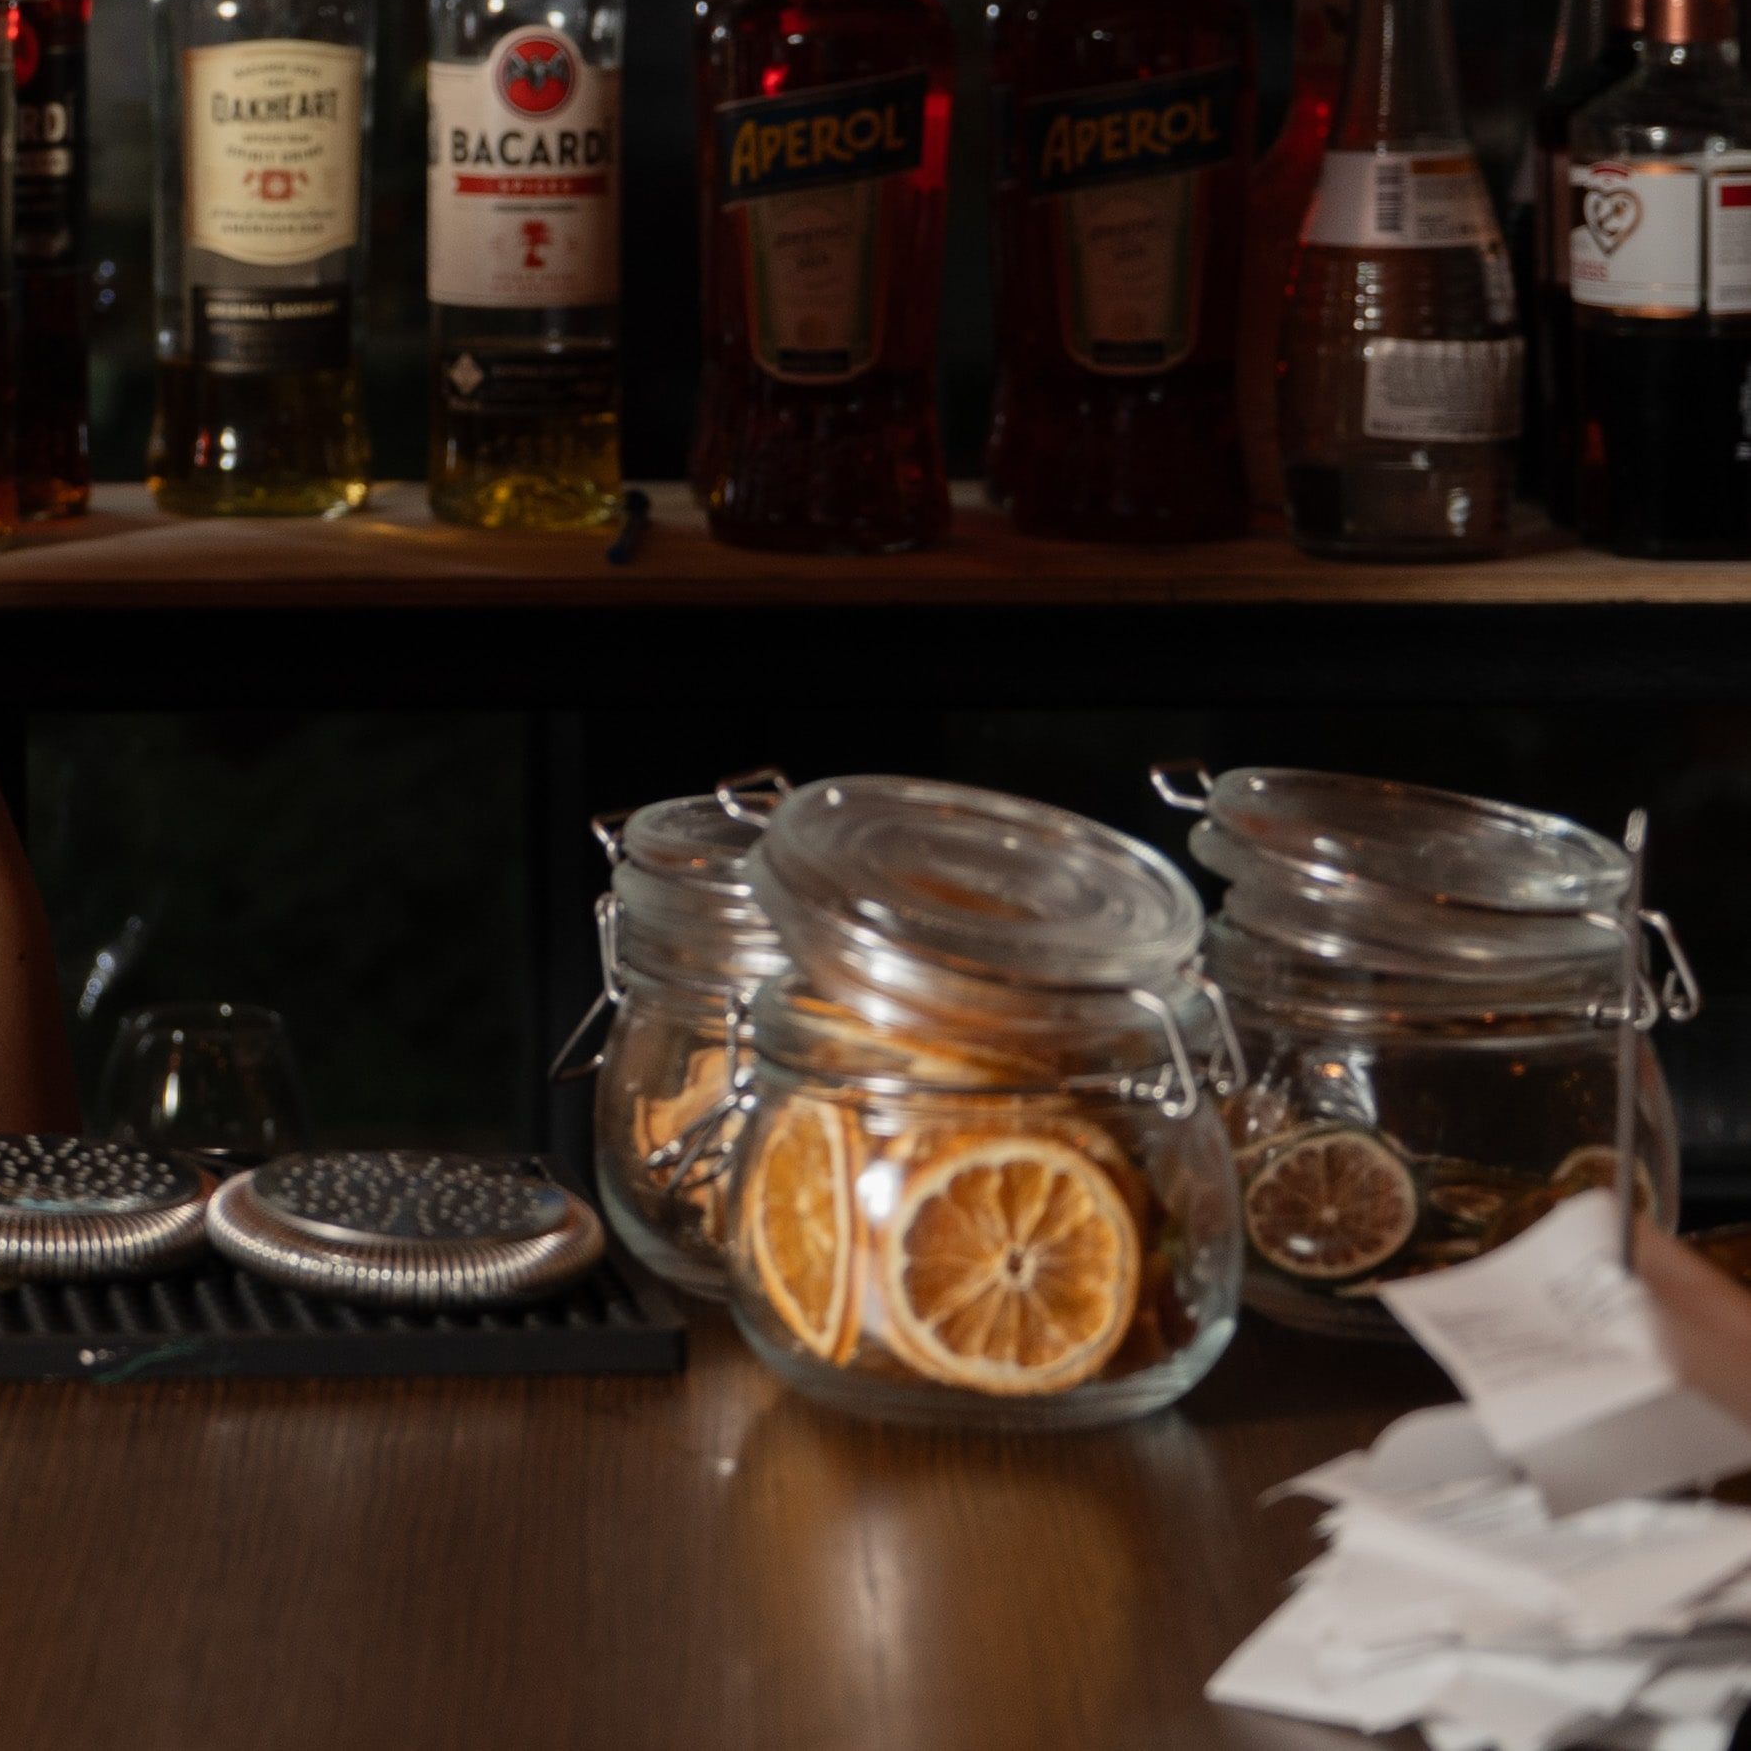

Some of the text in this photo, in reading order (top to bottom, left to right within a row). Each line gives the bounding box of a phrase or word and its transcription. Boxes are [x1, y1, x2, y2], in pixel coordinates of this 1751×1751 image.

[452, 128, 609, 167] BACARD
[729, 105, 906, 185] APEROL
[1041, 98, 1220, 180] APEROL
